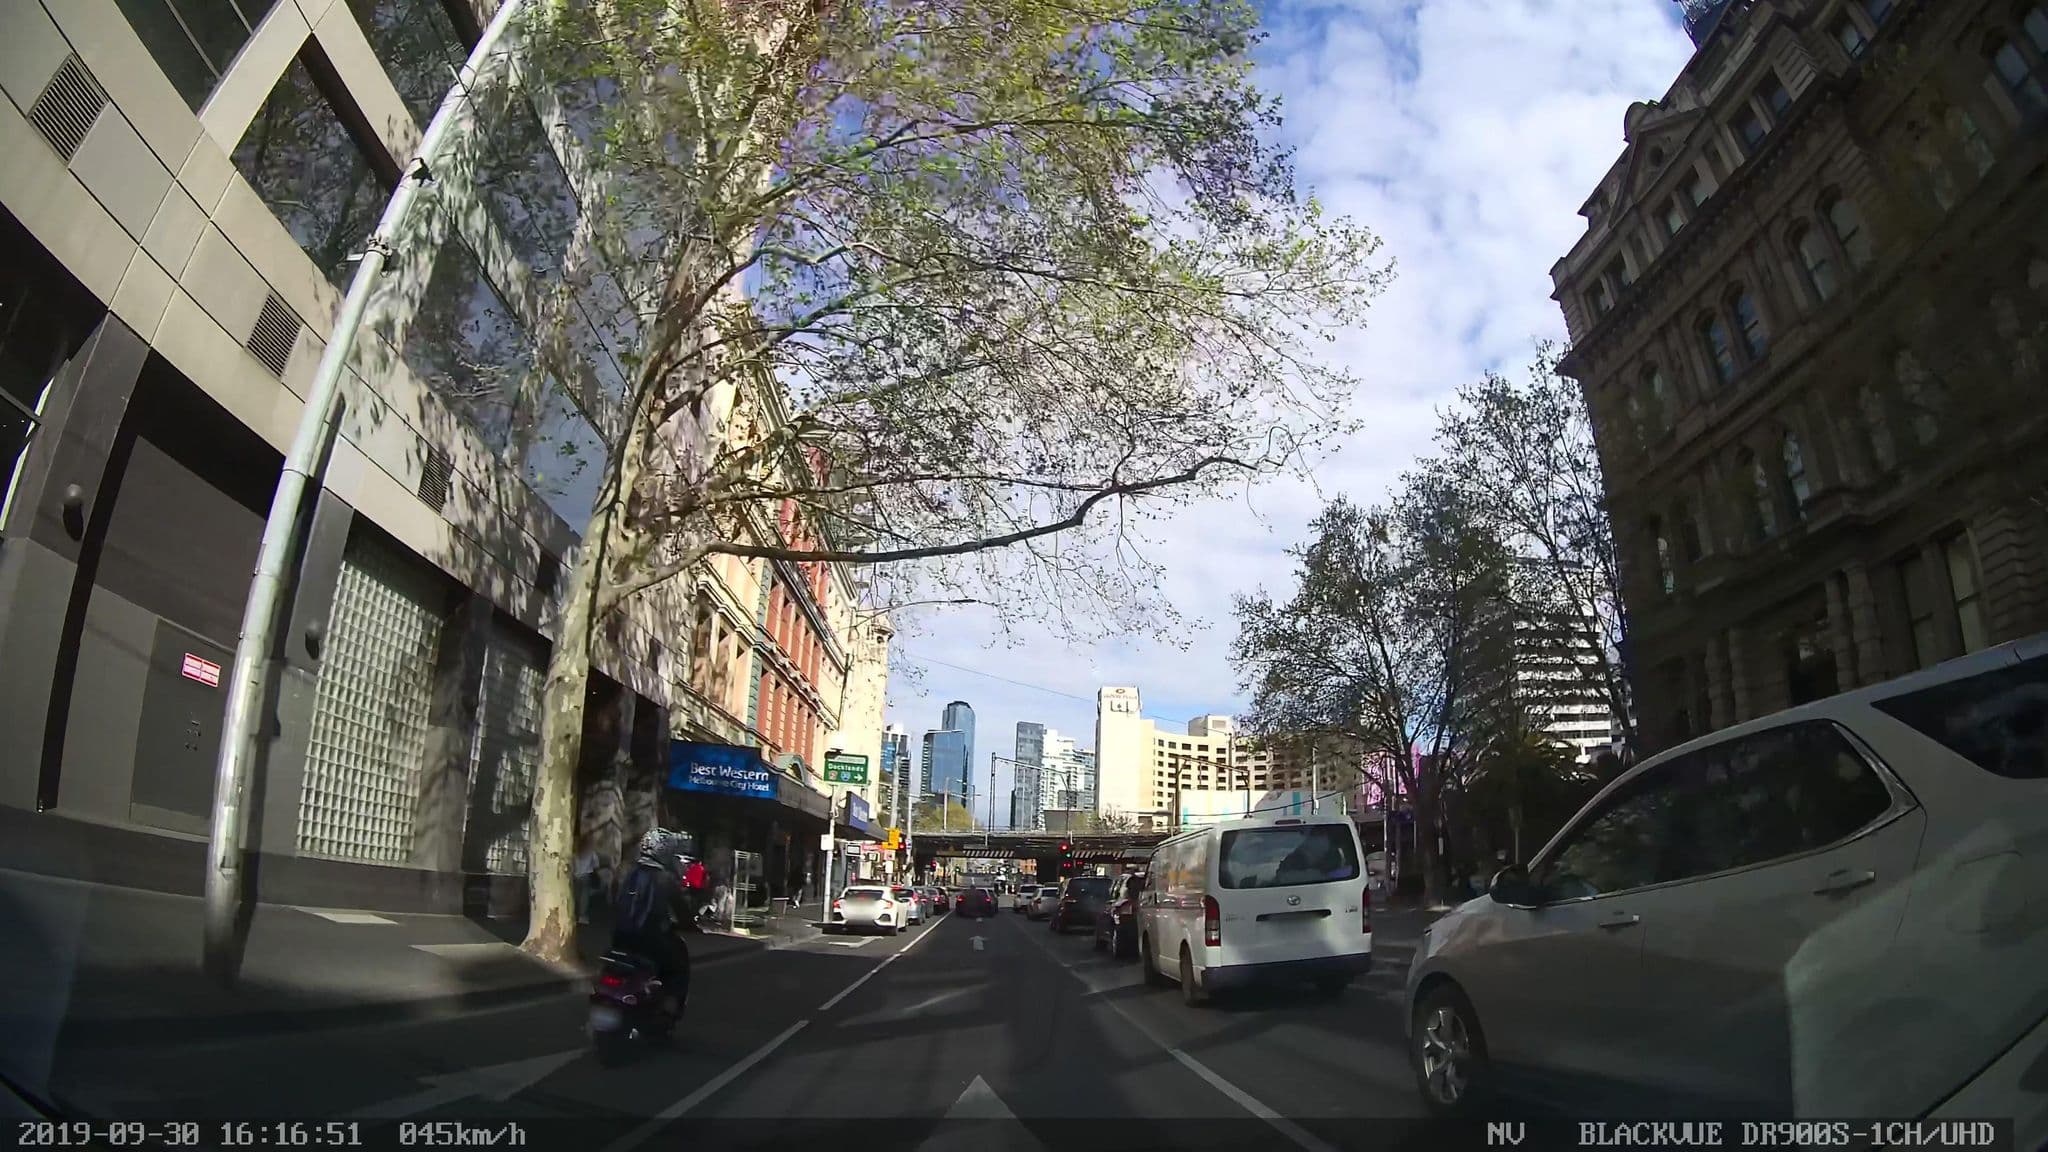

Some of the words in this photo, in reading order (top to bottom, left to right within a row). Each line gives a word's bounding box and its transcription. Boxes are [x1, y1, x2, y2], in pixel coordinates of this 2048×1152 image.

[690, 762, 717, 777] Best
[719, 765, 769, 781] Western
[828, 762, 864, 773] Docklands
[689, 775, 729, 787] Melboe
[747, 782, 769, 792] Hotel
